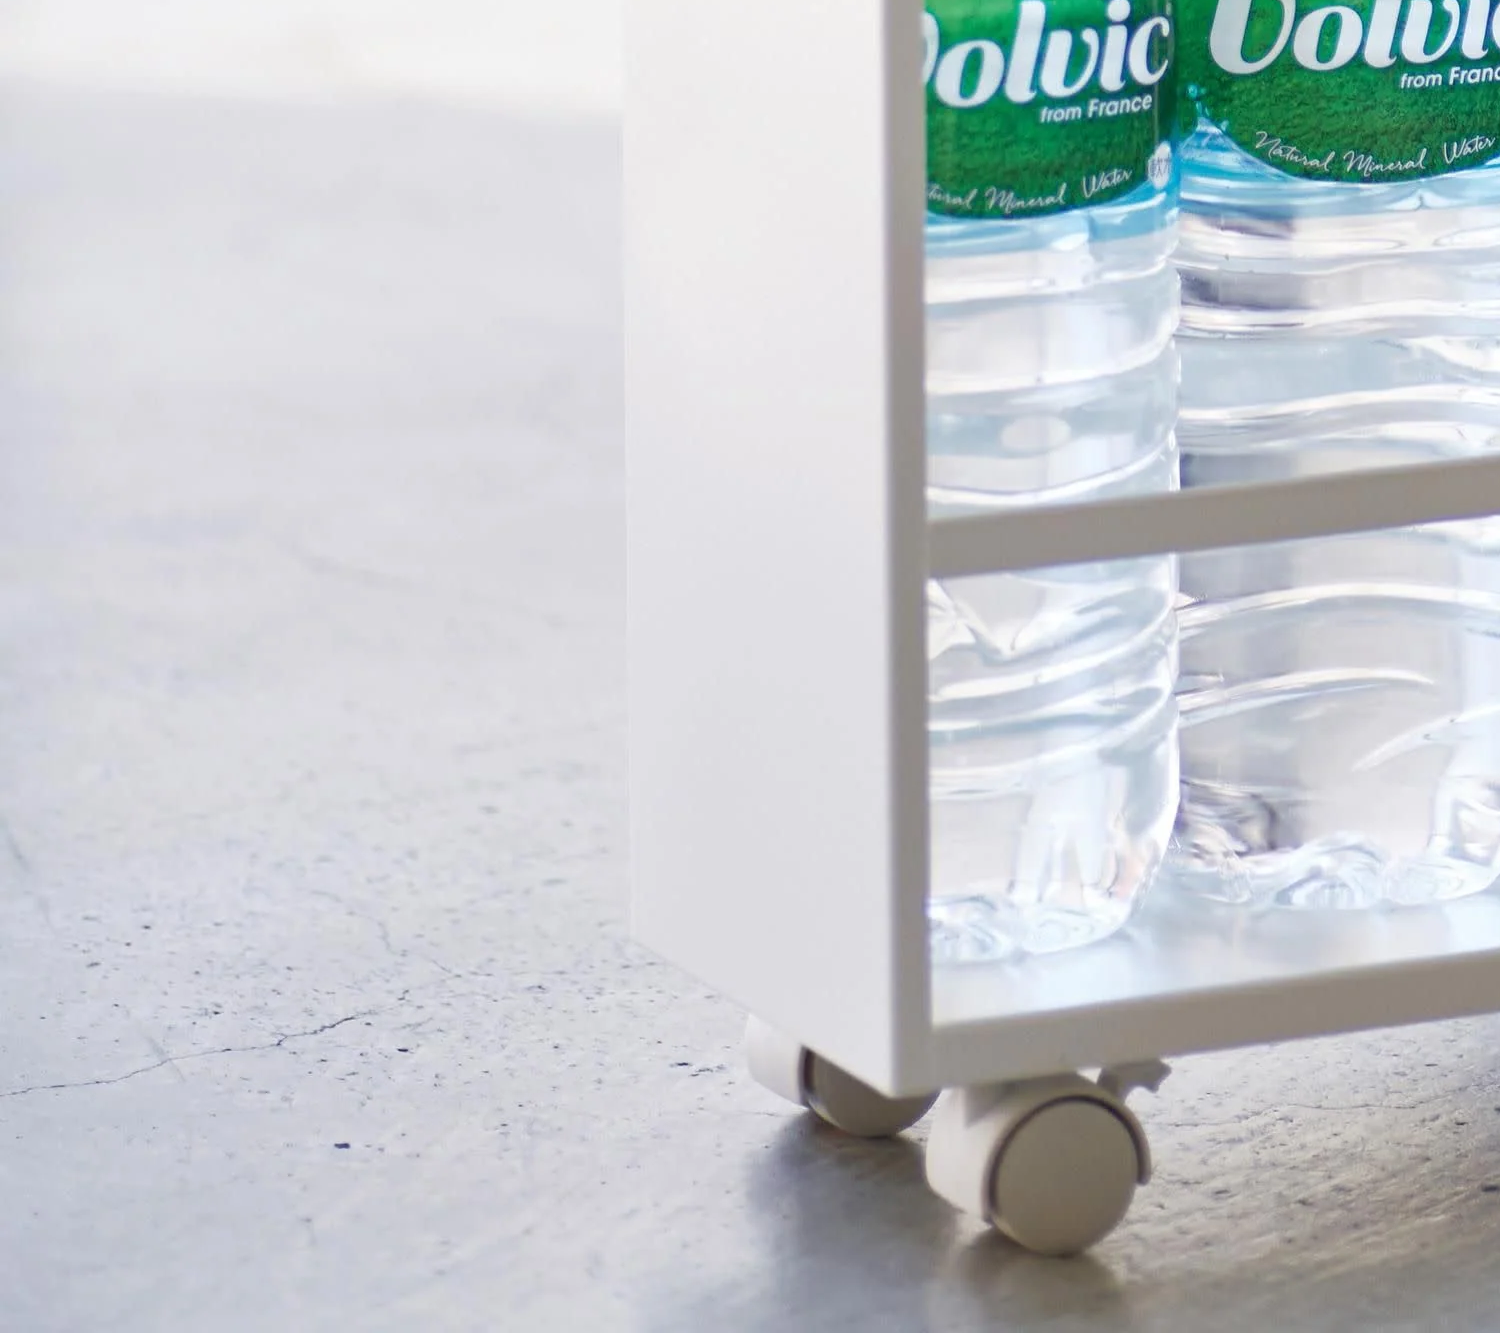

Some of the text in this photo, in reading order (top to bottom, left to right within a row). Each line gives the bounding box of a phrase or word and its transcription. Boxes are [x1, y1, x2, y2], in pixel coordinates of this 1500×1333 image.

[1400, 71, 1443, 89] from
[1040, 94, 1153, 124] from France
[1254, 130, 1496, 178] Natural Mineral Water
[927, 167, 1134, 214] tural Mineral Water
